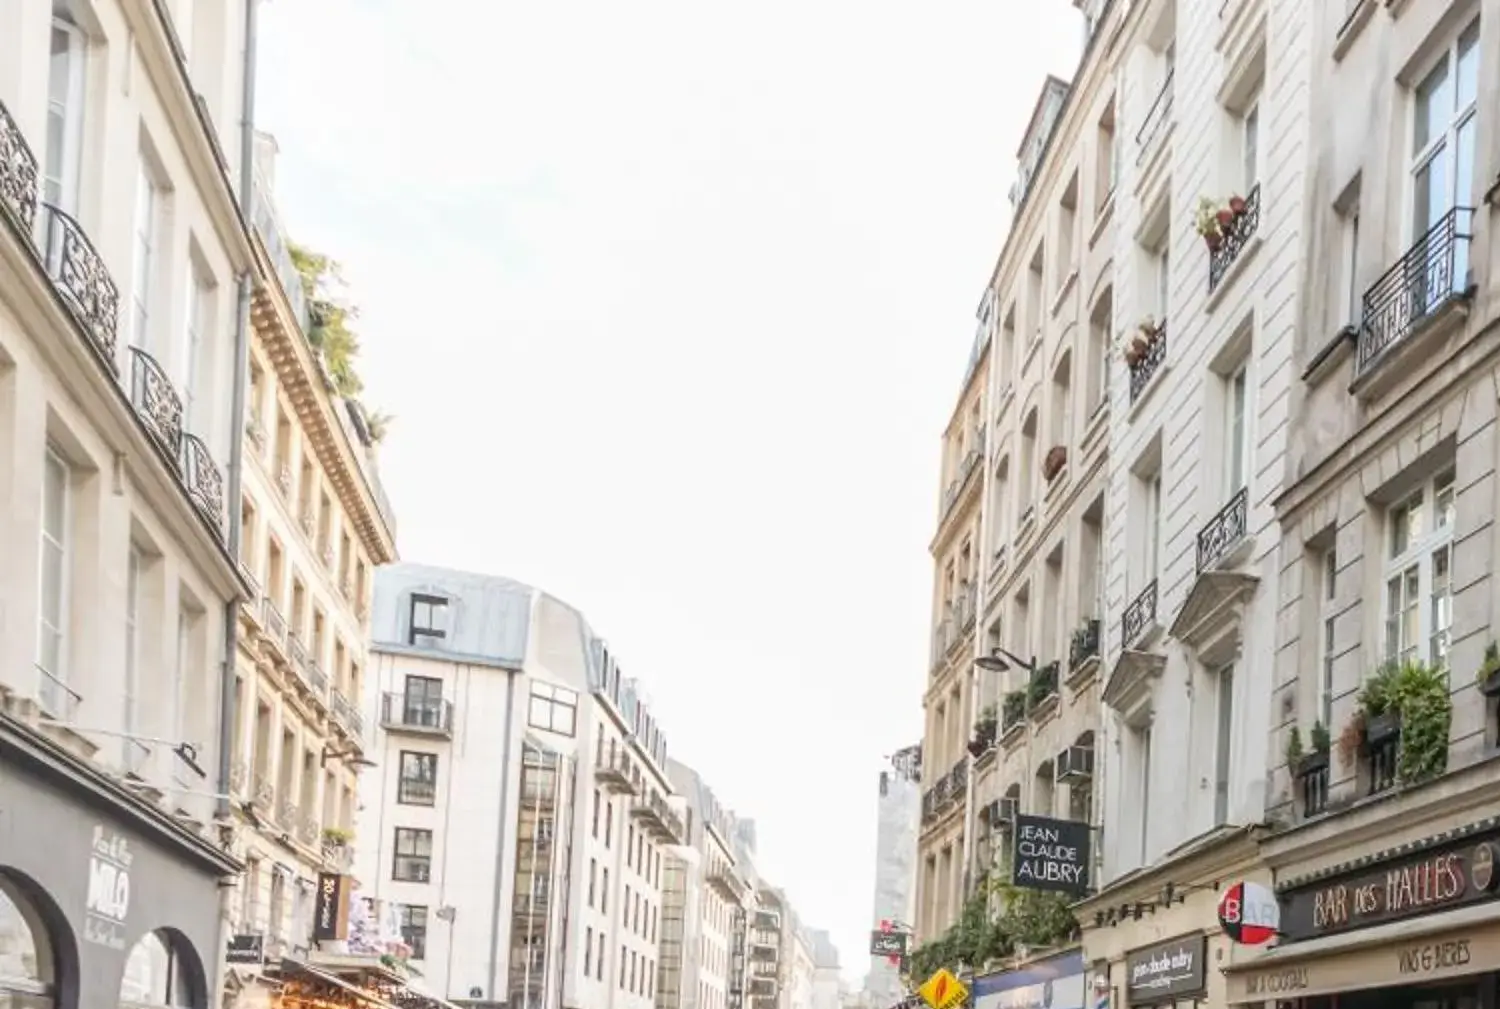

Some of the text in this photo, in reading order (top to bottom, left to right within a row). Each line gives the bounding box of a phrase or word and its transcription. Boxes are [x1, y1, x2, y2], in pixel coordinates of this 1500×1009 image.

[1020, 825, 1059, 842] JEAN
[1019, 841, 1077, 861] CLAUDE
[1017, 861, 1084, 884] AUBRY
[1313, 884, 1349, 928] BAR
[1385, 853, 1460, 913] HALLES
